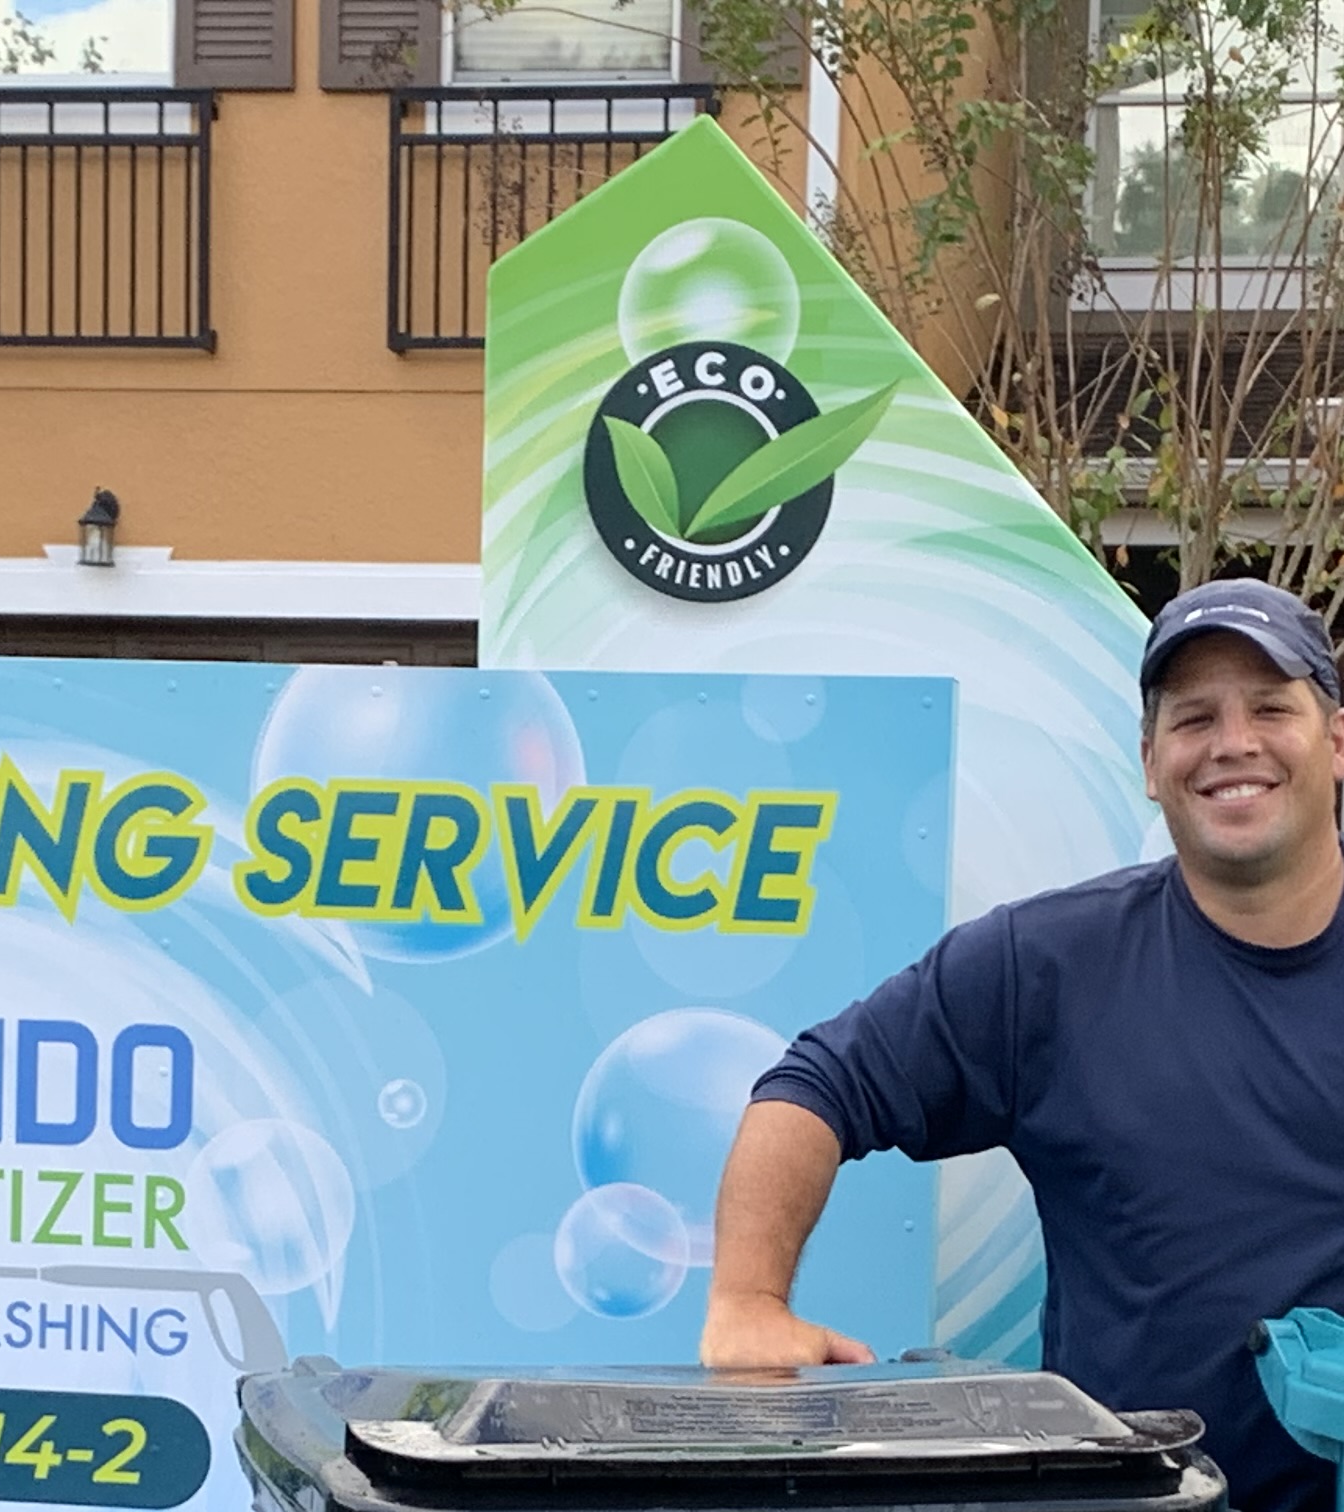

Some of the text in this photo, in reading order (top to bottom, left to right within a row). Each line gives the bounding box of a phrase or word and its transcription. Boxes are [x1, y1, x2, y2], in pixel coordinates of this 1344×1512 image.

[648, 351, 775, 400] ECO
[638, 544, 776, 589] FRIENDLY
[237, 770, 840, 942] SERVICE
